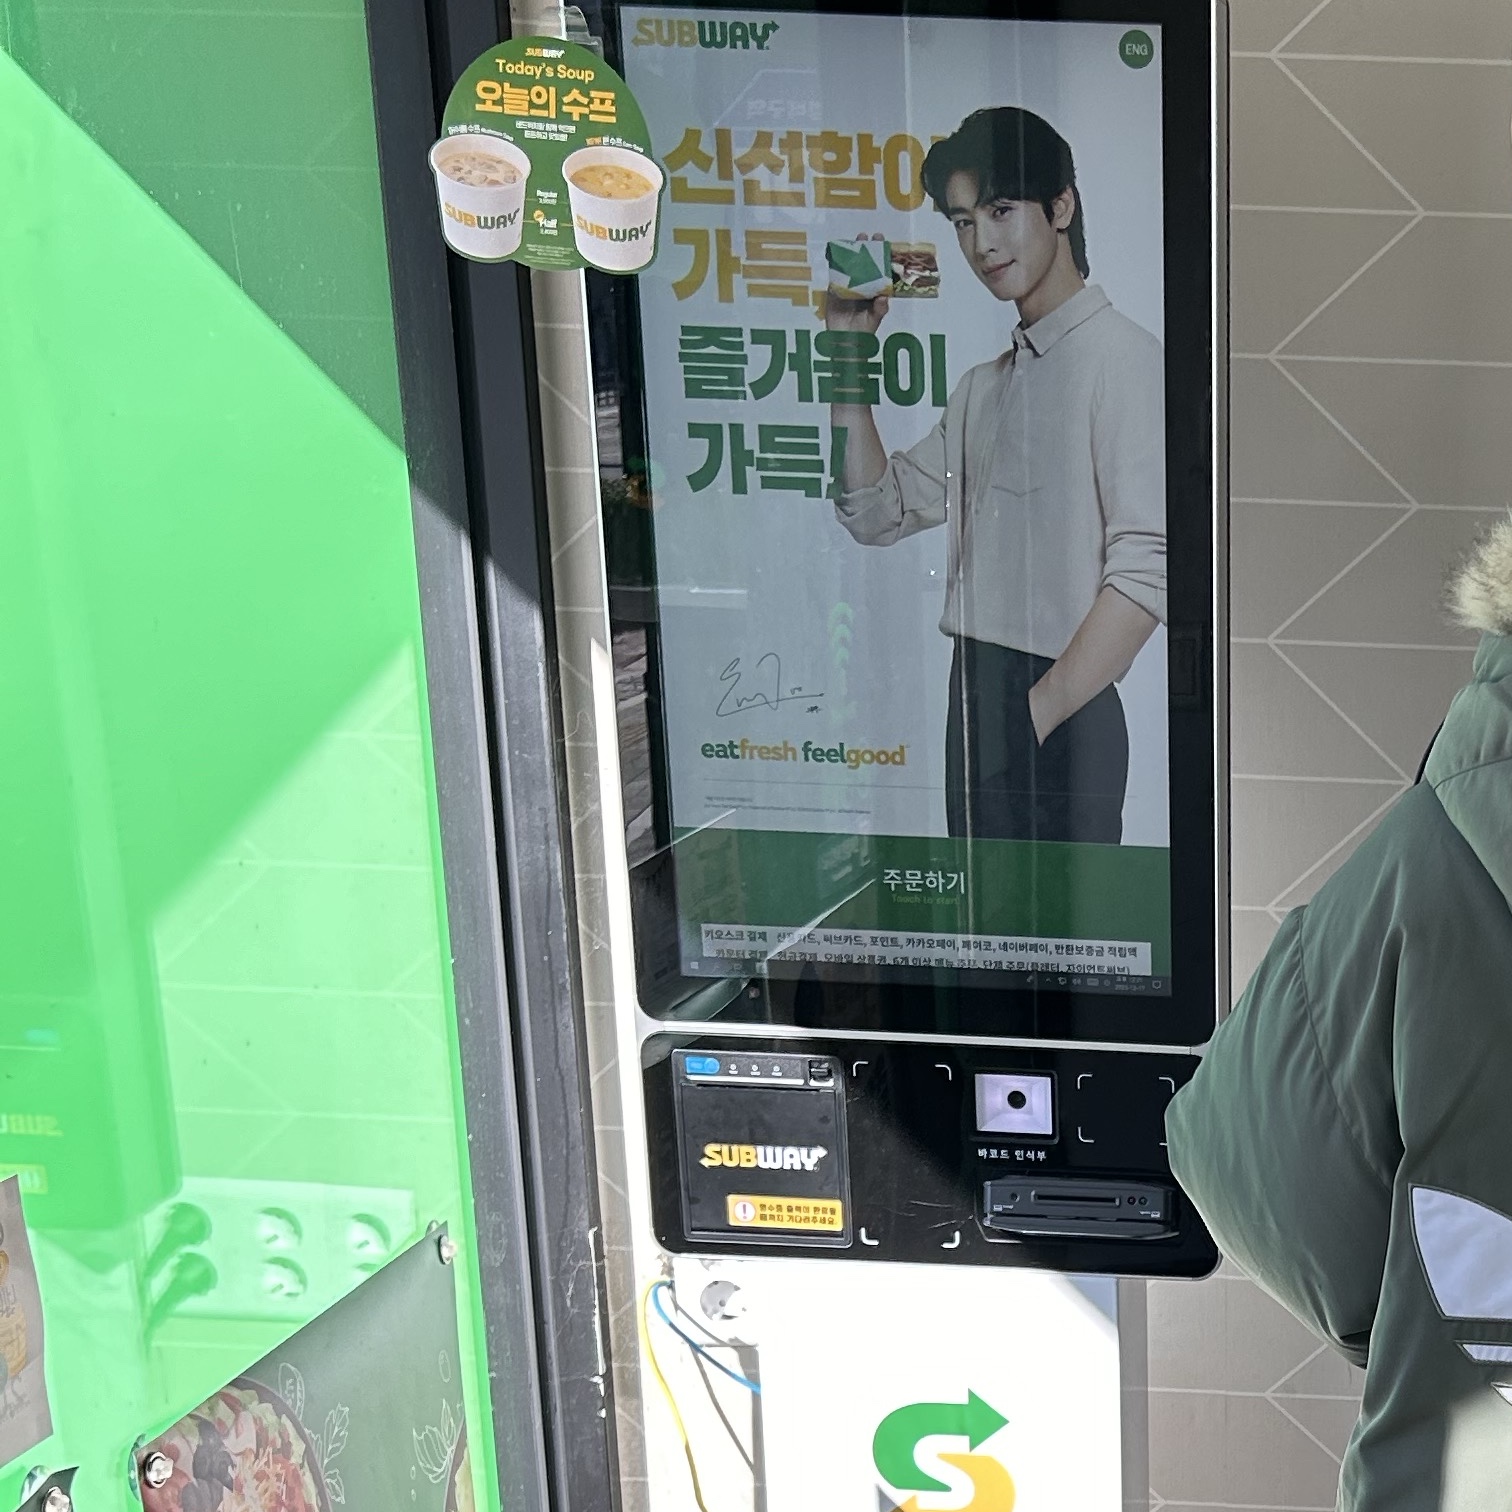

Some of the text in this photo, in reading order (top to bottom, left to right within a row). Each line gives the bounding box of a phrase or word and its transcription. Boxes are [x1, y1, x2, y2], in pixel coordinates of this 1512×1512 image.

[631, 19, 779, 50] SUBWAY
[525, 47, 565, 59] SUBWAY
[1125, 42, 1149, 57] ENG
[495, 58, 595, 84] Today's Soup
[475, 80, 617, 123] 오늘의 수프
[662, 127, 946, 213] 신선함이
[443, 201, 520, 230] SUBWAY
[575, 213, 652, 243] SUBWAY
[678, 325, 948, 408] 즐거움이
[883, 869, 965, 894] 주문하기
[704, 929, 745, 941] 키오스크
[748, 931, 768, 943] 결제
[869, 936, 904, 949] 포인트,
[905, 937, 960, 952] 카카오페이,
[998, 941, 1052, 956] 네이버페이,
[700, 1143, 828, 1171] SUBWAY
[977, 1148, 1047, 1162] 바코드 인식부
